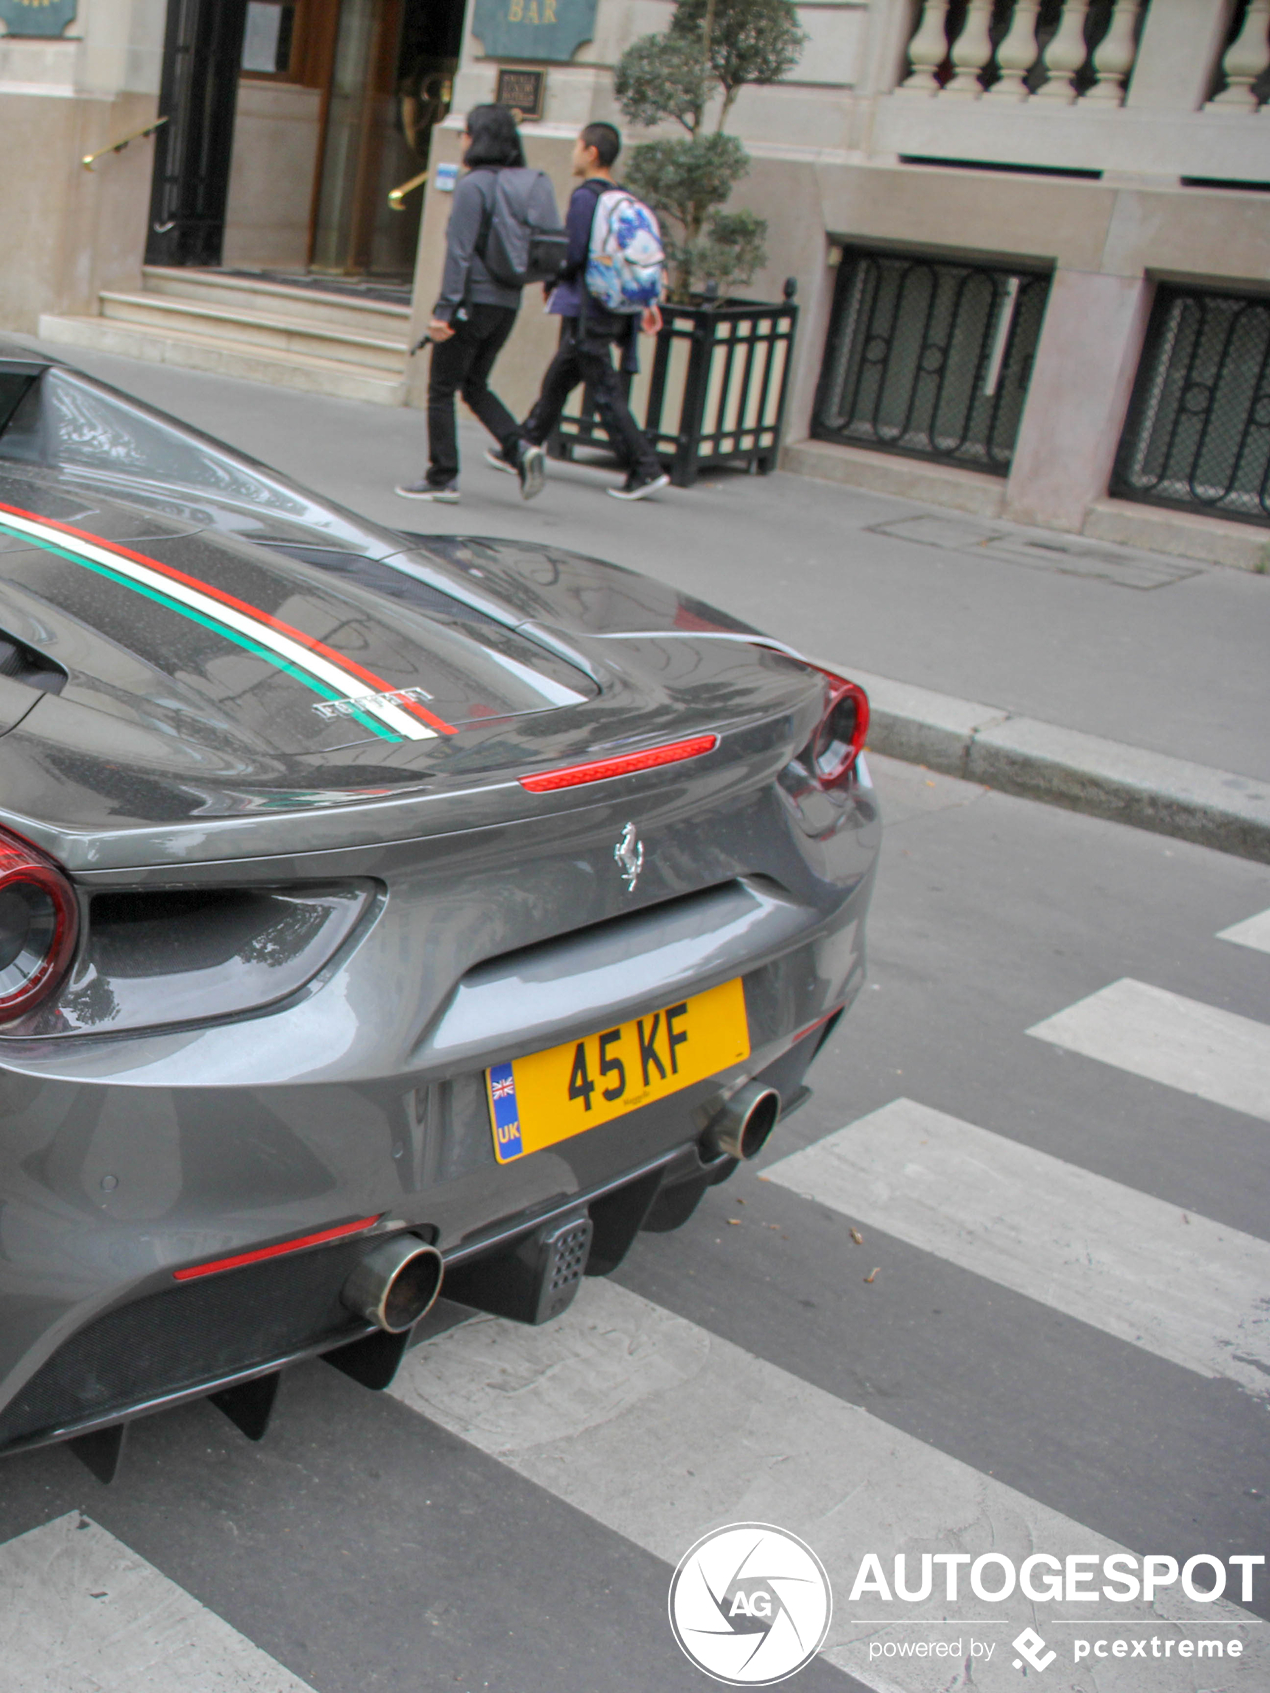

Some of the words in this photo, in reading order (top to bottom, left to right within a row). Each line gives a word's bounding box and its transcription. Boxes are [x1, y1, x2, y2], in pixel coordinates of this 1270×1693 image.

[508, 0, 558, 24] BAR
[312, 687, 434, 721] Ferrari
[567, 1028, 626, 1112] 45
[636, 1001, 689, 1087] KF
[497, 1121, 521, 1144] UK
